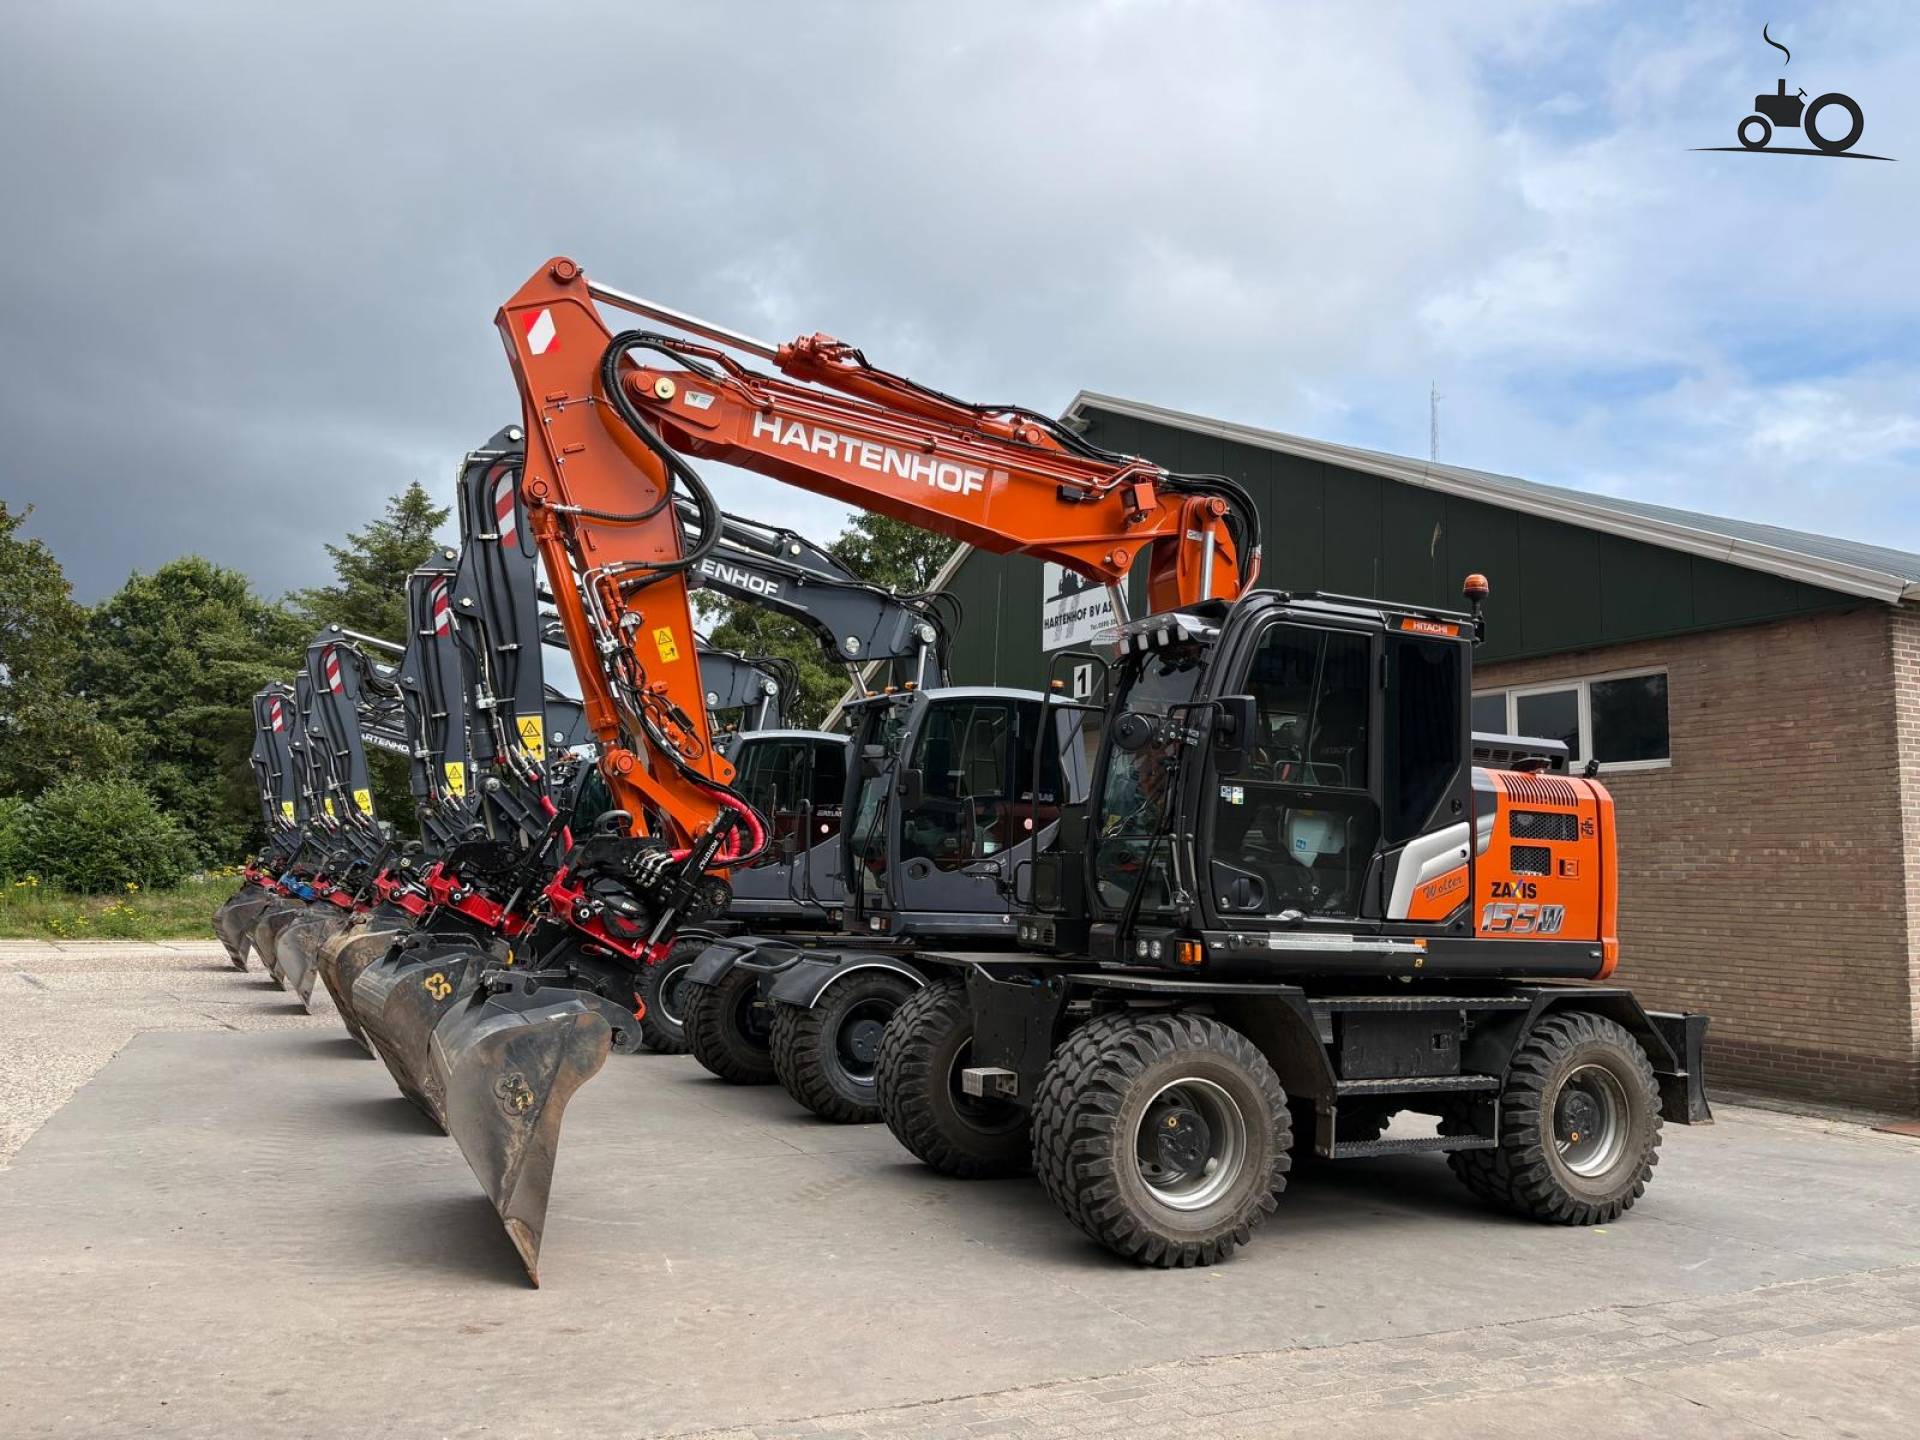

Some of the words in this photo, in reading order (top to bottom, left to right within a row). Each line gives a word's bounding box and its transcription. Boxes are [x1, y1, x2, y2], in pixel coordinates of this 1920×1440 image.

[752, 411, 985, 496] HARTENHOF
[692, 559, 779, 595] ENHOF
[1044, 608, 1087, 630] HARTENHOF
[1413, 621, 1448, 635] HITACHI
[1077, 667, 1087, 695] 1
[1423, 876, 1464, 899] Wolter
[1491, 880, 1537, 899] ZAXIS
[1481, 902, 1566, 934] 155W
